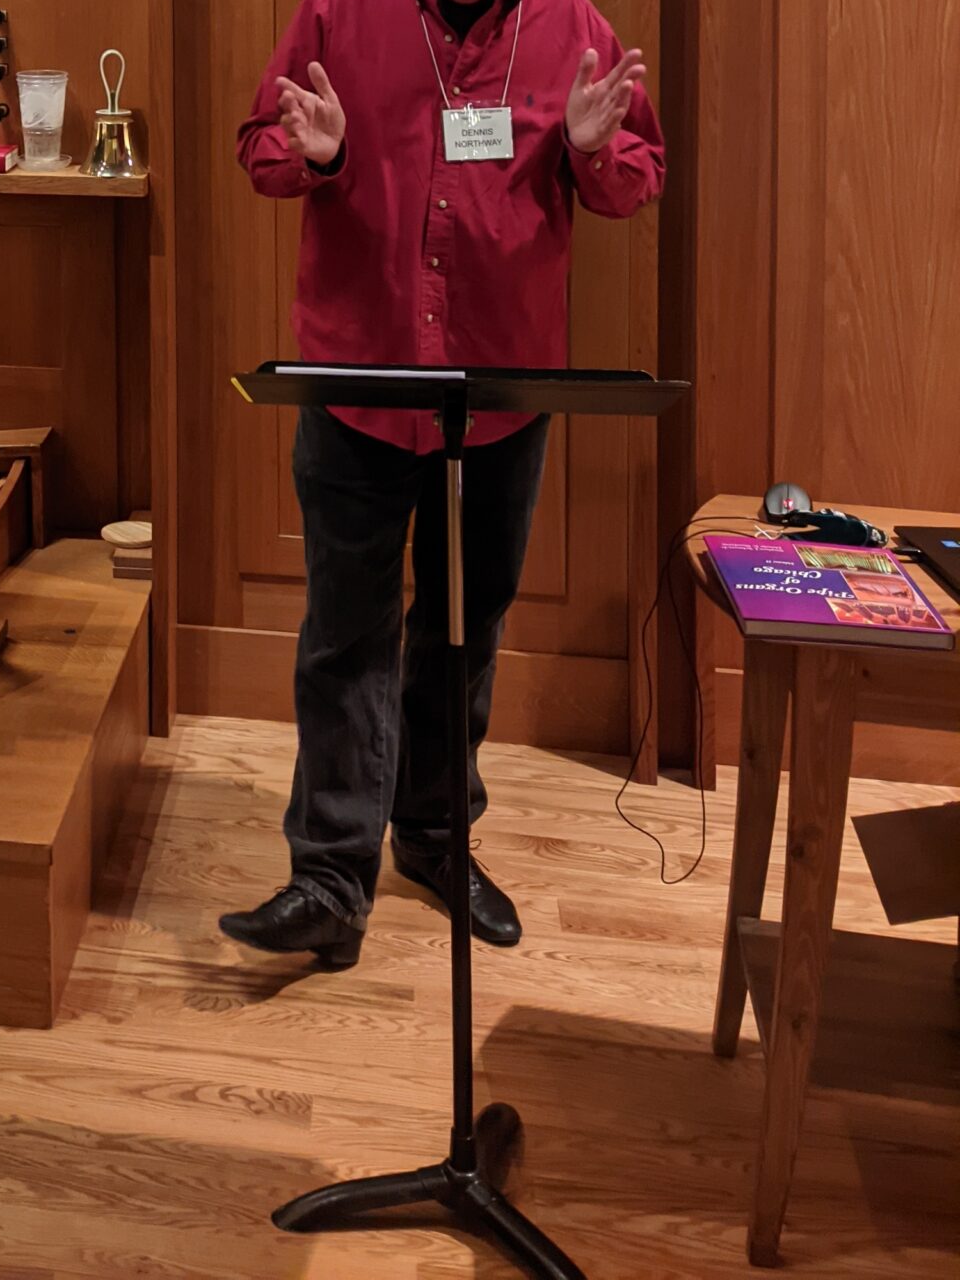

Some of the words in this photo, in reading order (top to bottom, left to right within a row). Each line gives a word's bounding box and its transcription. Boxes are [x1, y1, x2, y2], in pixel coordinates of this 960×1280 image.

[461, 128, 493, 137] DENNIS
[455, 139, 502, 148] NORTHWAY
[753, 566, 822, 579] Chicago
[780, 576, 801, 586] of
[735, 583, 802, 594] Organs
[807, 588, 855, 599] Pipe
